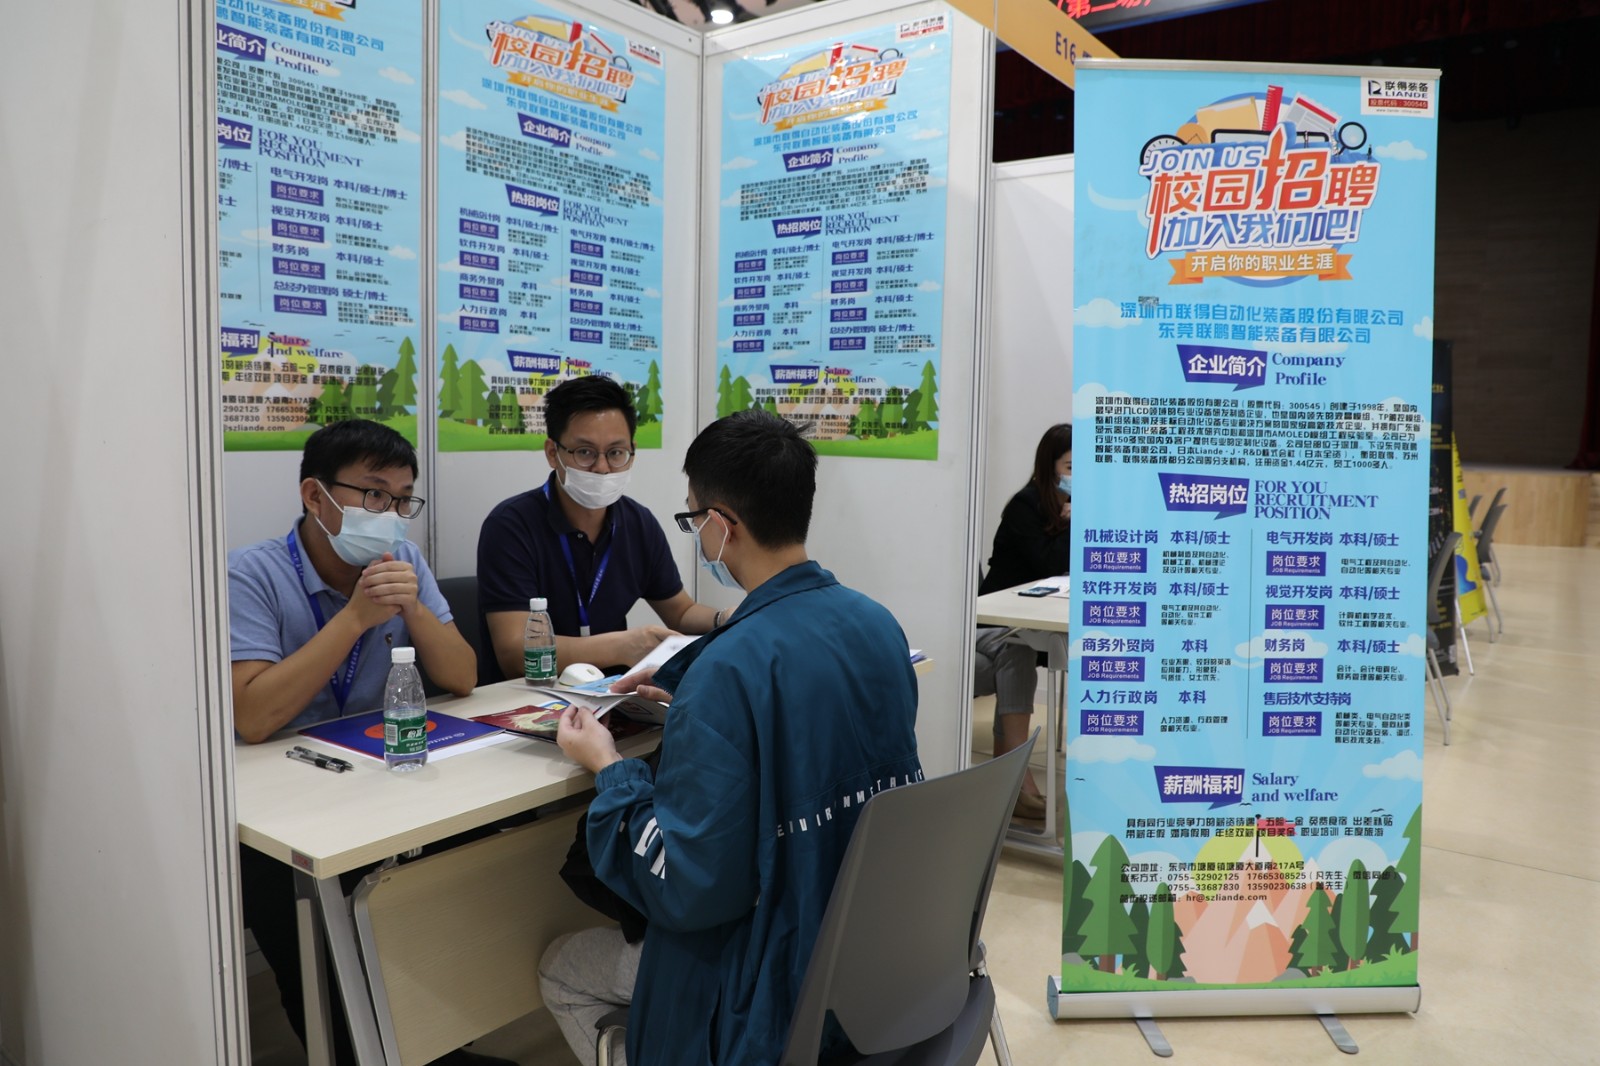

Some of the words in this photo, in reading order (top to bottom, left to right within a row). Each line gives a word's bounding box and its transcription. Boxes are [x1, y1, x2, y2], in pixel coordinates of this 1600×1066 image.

[271, 41, 333, 67] Company
[493, 34, 636, 90] 校园招聘
[275, 56, 319, 76] Profile
[1385, 80, 1428, 92] 联得装备
[1385, 91, 1428, 99] LIANDE
[258, 128, 293, 144] FOR
[296, 135, 323, 150] YOU
[1142, 150, 1212, 173] JOIN
[1223, 149, 1263, 168] US
[270, 166, 329, 186] 电气开发岗
[1146, 130, 1380, 248] 校园招聘
[271, 205, 330, 223] 视觉开发岗
[335, 216, 383, 232] 本科/硕士
[272, 243, 309, 257] 财务岗
[336, 252, 385, 267] 本科/硕士
[1191, 252, 1334, 273] 开启你的职业生涯
[1120, 301, 1404, 327] 深圳市联得自动化装备股份有限公司
[1158, 322, 1371, 345] 东莞联鹏智能装备有限公司
[1188, 353, 1266, 378] 企业简介
[1272, 352, 1346, 369] Company
[1275, 371, 1327, 387] Profile
[1169, 483, 1247, 505] 热招岗位
[1254, 480, 1287, 494] FOR
[1291, 481, 1328, 495] YOU
[1254, 494, 1379, 508] RECRUITMENT
[1254, 506, 1331, 520] POSITION
[1084, 529, 1158, 544] 机械设计岗
[1170, 530, 1231, 546] 本科/硕士
[1266, 531, 1333, 546] 电气开发岗
[1339, 532, 1399, 547] 本科/硕士
[1090, 551, 1141, 564] 岗位要求
[1272, 555, 1321, 568] 岗位要求
[1082, 580, 1157, 596] 软件开发岗
[1169, 582, 1230, 597] 本科/硕士
[1265, 584, 1333, 599] 视觉开发岗
[1339, 586, 1400, 601] 本科/硕士
[1089, 605, 1140, 618] 岗位要求
[1271, 608, 1319, 621] 岗位要求
[1082, 638, 1155, 653] 商务外贸岗
[1181, 639, 1208, 653] 本科
[1264, 638, 1305, 653] 财务岗
[1337, 639, 1400, 654] 本科/硕士
[1088, 660, 1139, 673] 岗位要求
[1270, 662, 1318, 675] 岗位要求
[1080, 690, 1158, 704] 人力行政岗
[1178, 690, 1207, 704] 本科
[1263, 692, 1351, 706] 售后技术支持岗
[1087, 714, 1139, 727] 岗位要求
[1268, 715, 1317, 728] 岗位要求
[1164, 774, 1243, 795] 薪酬福利
[1252, 772, 1299, 787] Salary
[1251, 789, 1280, 802] and
[1284, 788, 1338, 802] welfare
[1167, 883, 1240, 892] 0755-33687830
